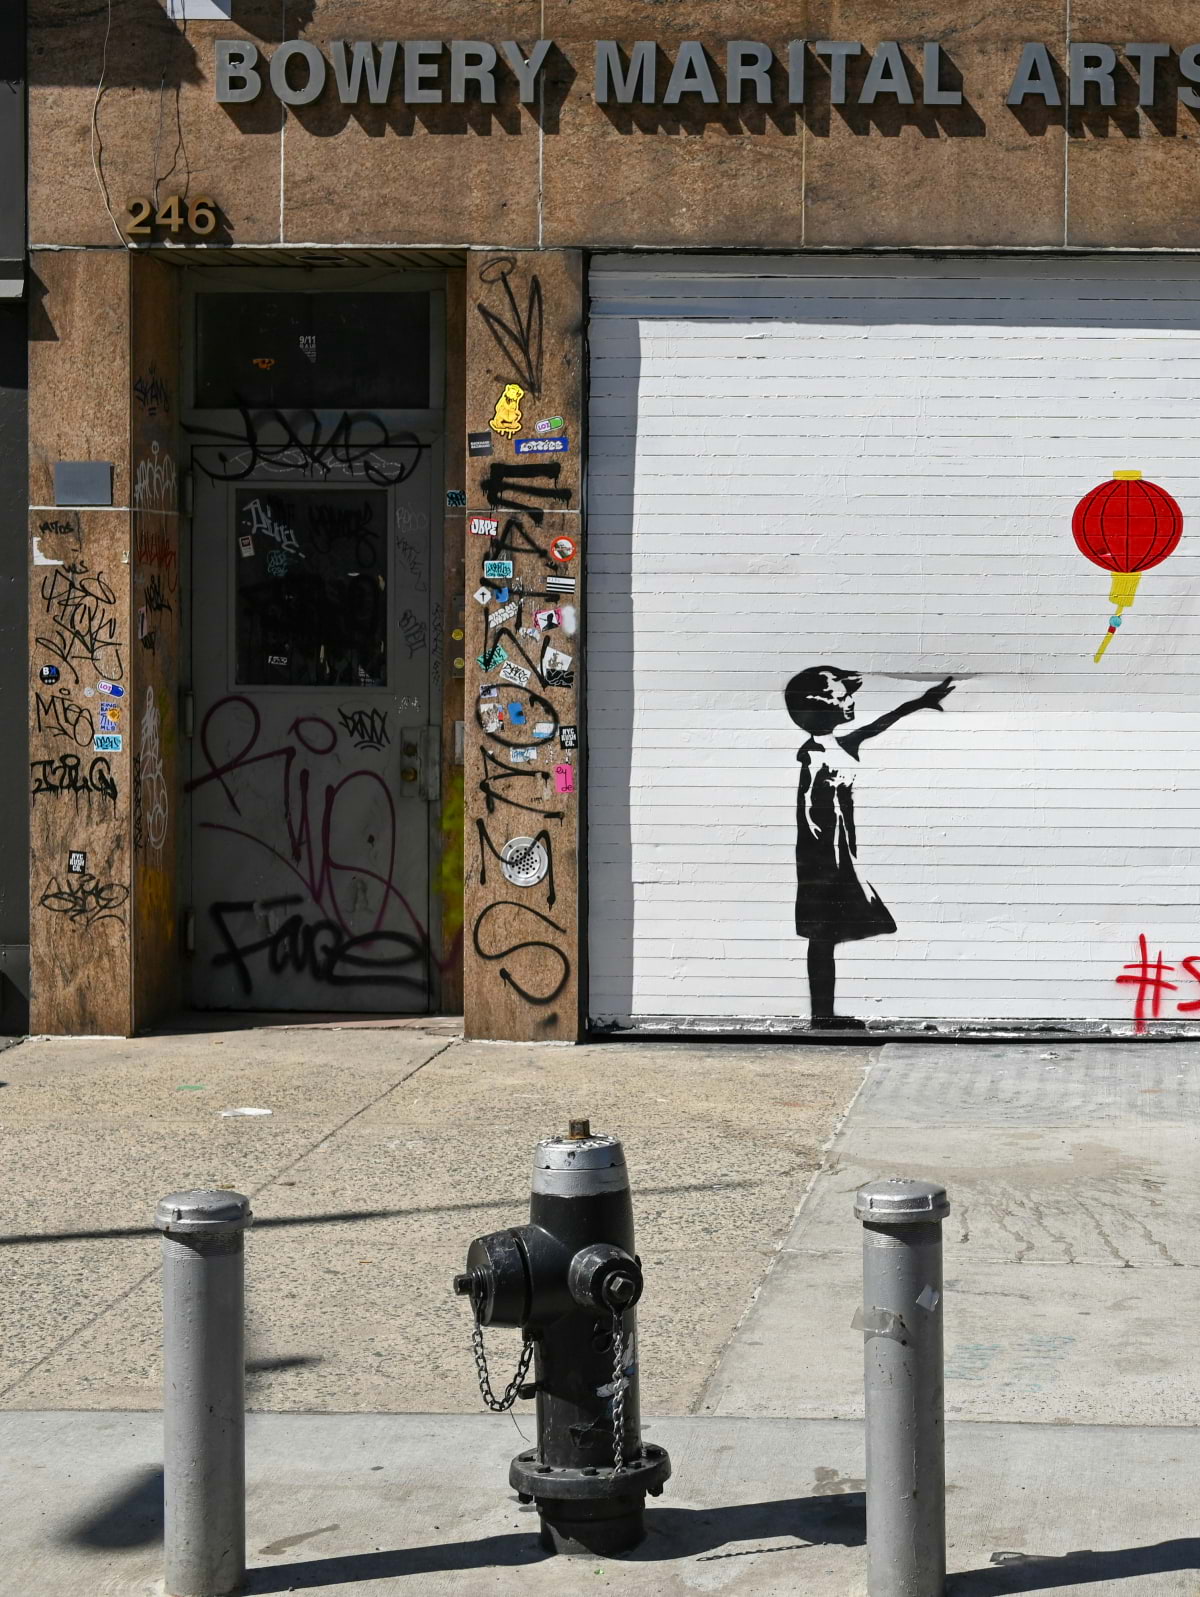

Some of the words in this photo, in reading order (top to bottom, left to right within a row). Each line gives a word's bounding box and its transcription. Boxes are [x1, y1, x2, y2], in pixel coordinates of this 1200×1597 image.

[214, 39, 554, 105] BOWERY
[594, 40, 963, 105] MARITAL
[125, 195, 218, 236] 246
[99, 684, 112, 692] LOT
